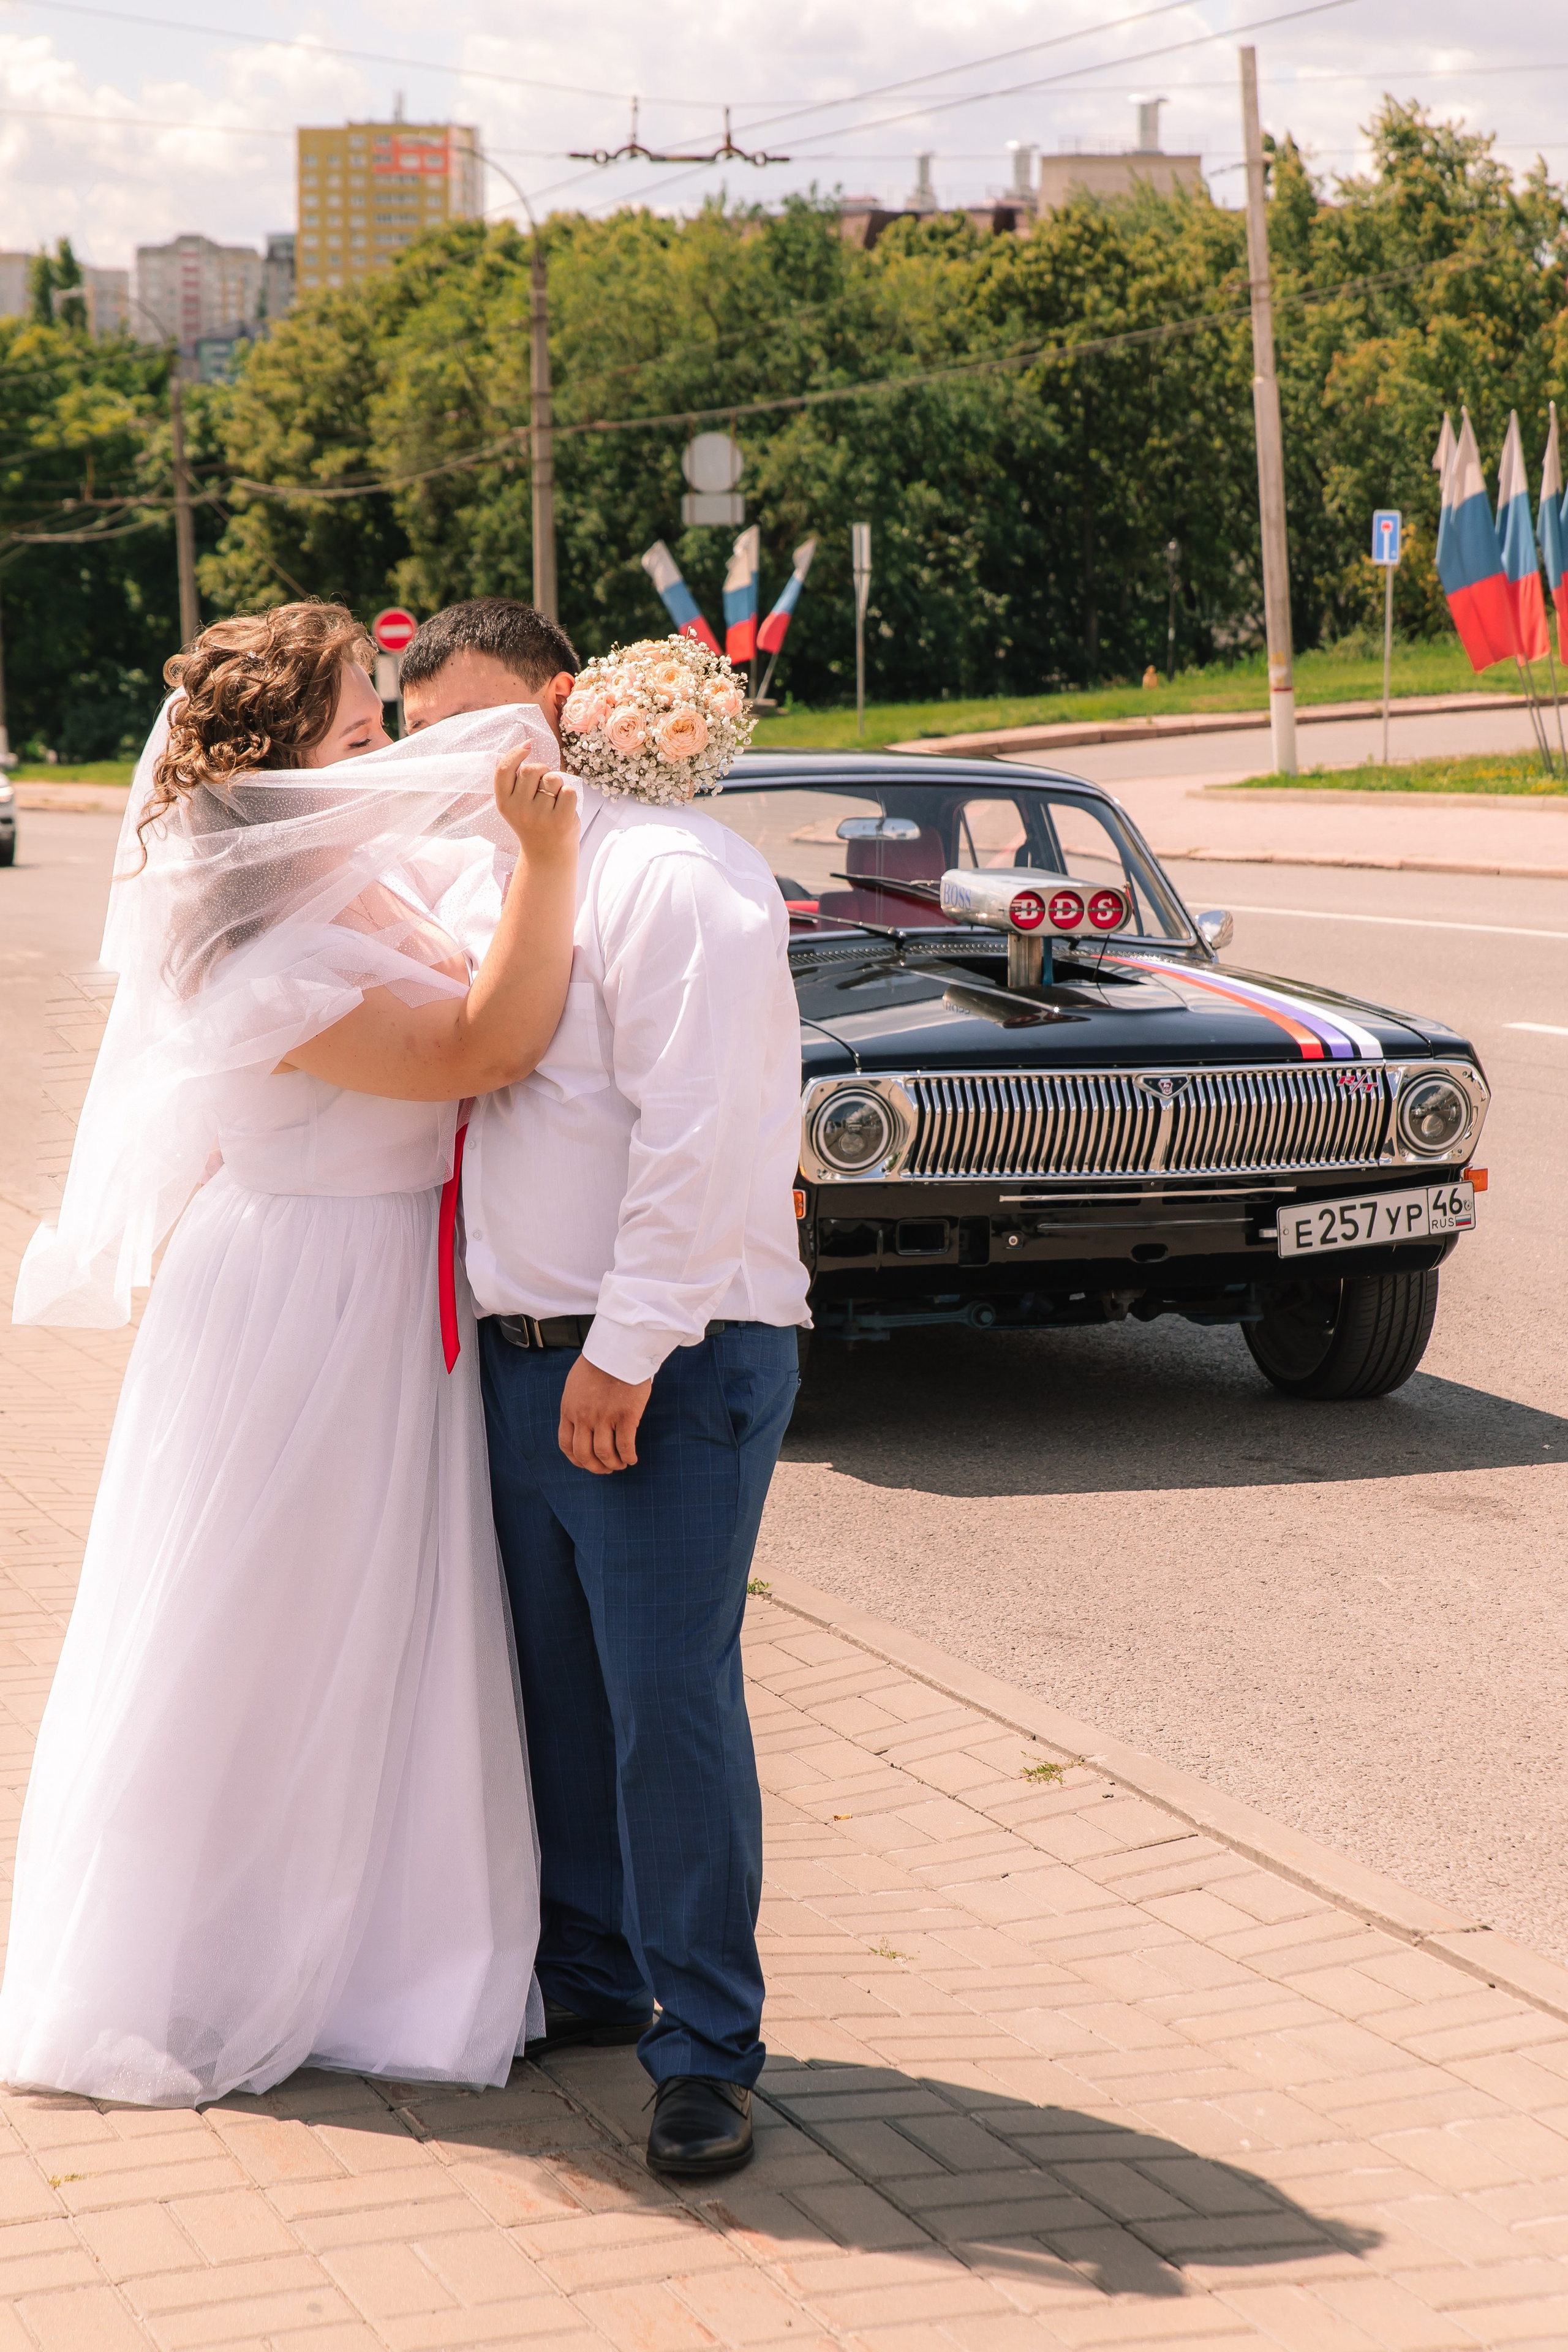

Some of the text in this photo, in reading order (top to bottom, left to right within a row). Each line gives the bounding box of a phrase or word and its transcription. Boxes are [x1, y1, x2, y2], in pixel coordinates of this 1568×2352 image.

[944, 883, 971, 910] BOSS
[1336, 1074, 1378, 1095] R/T
[1432, 1188, 1463, 1216] 46
[1432, 1217, 1455, 1230] RUS
